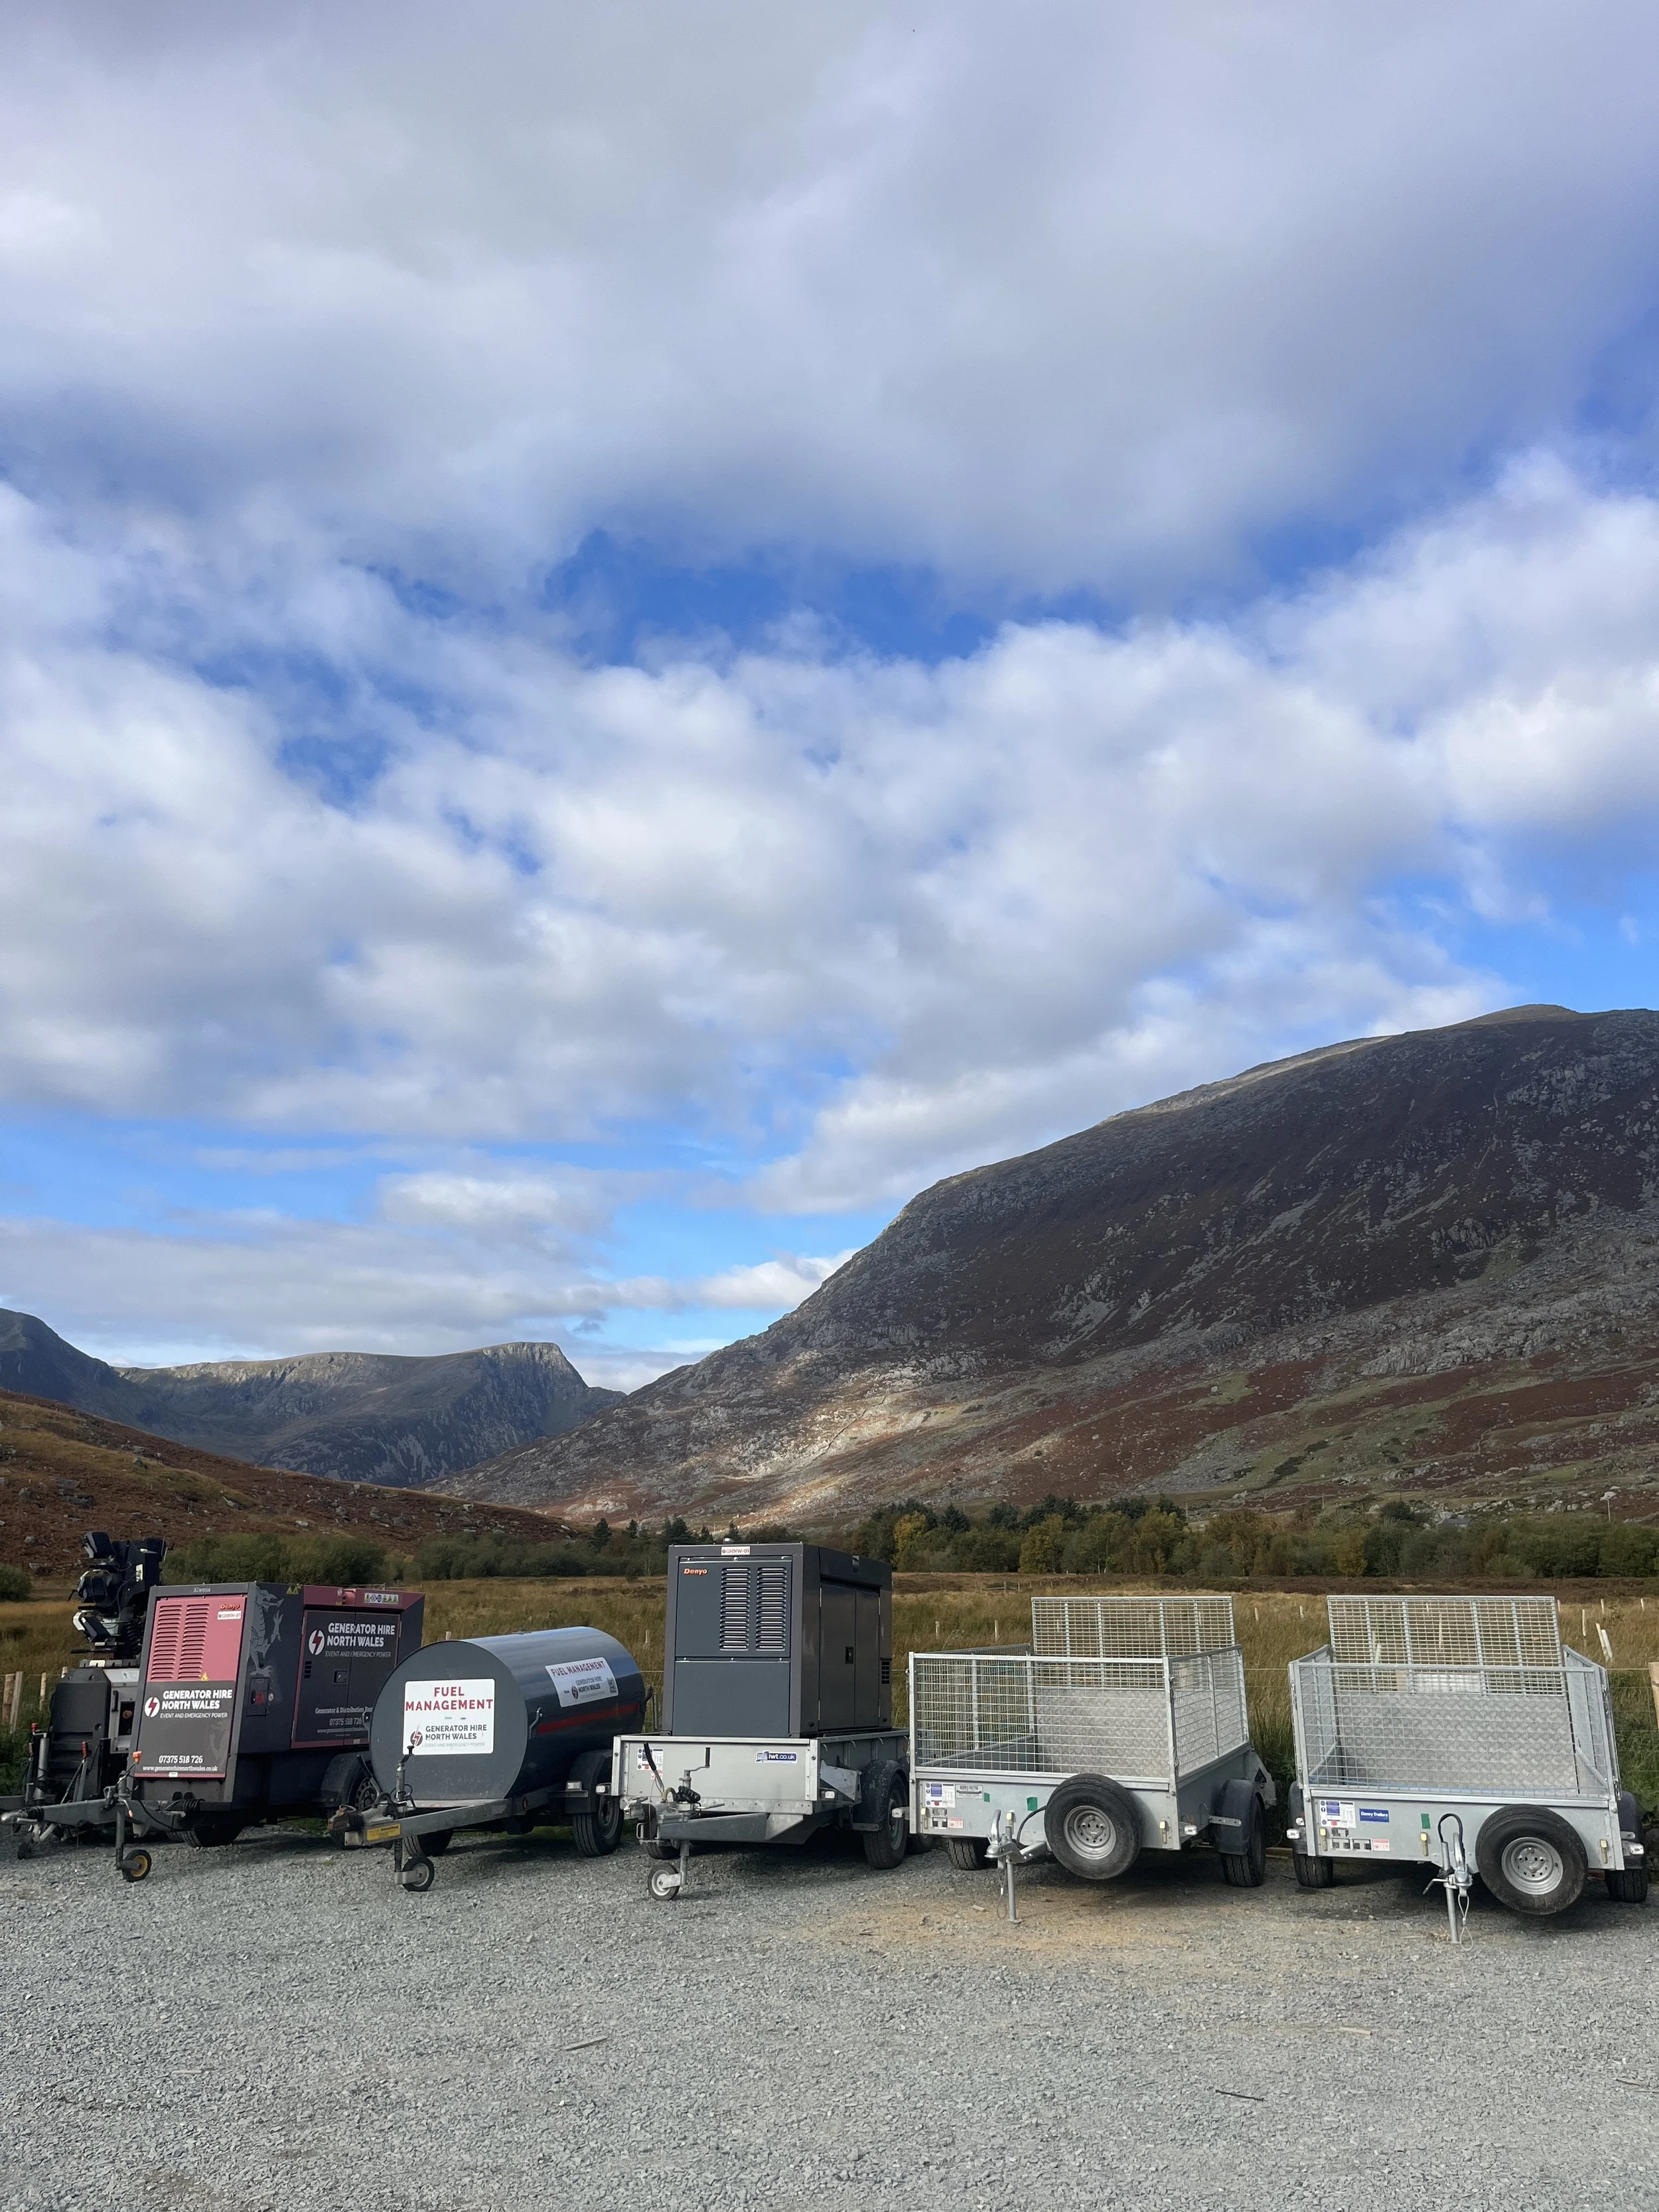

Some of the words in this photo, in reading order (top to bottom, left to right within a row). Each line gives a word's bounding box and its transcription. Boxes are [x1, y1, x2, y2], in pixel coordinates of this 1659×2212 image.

[328, 1623, 376, 1634] GENERATOR
[378, 1625, 395, 1635] HIRE
[326, 1636, 356, 1646] NORTH
[358, 1637, 384, 1647] WALES
[551, 1666, 568, 1676] FUEL
[567, 1660, 606, 1674] MANAGEMENT
[163, 1690, 212, 1699] GENERATOR
[212, 1689, 233, 1698] HIRE
[434, 1686, 465, 1696] FUEL
[162, 1701, 190, 1710] NORTH
[191, 1700, 220, 1709] WALES
[405, 1699, 493, 1711] MANAGEMENT
